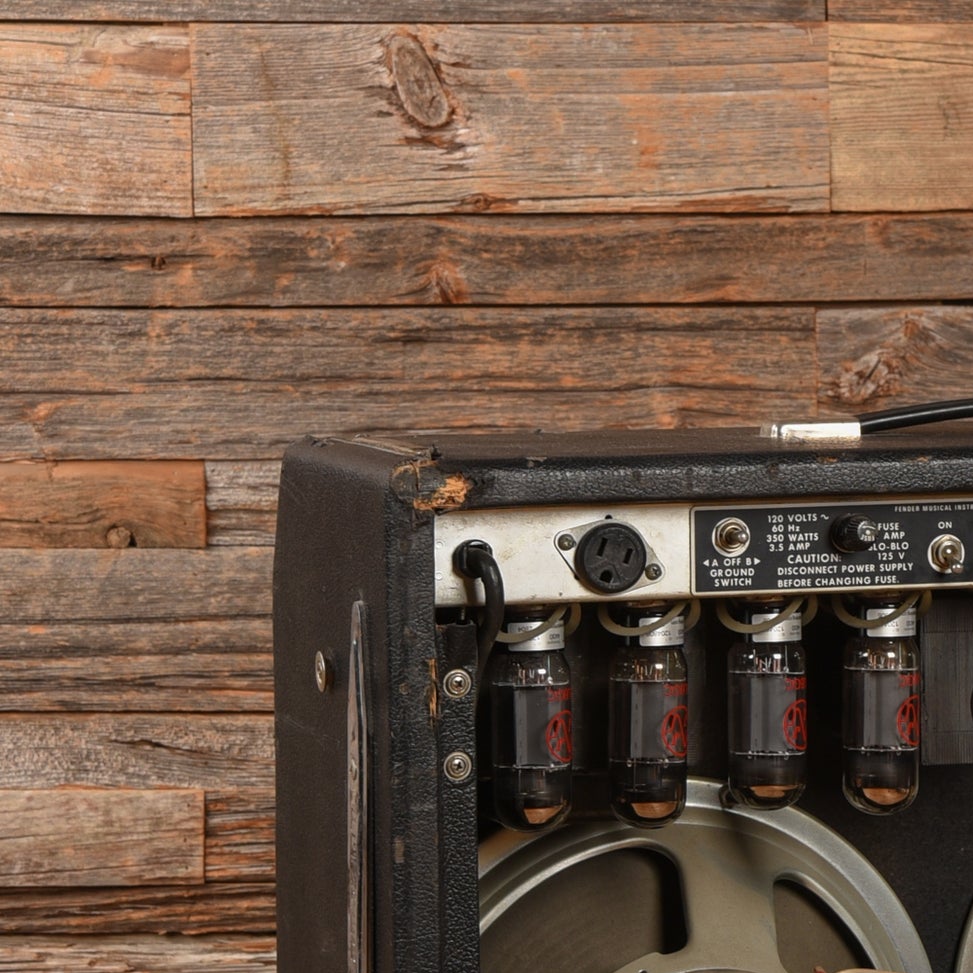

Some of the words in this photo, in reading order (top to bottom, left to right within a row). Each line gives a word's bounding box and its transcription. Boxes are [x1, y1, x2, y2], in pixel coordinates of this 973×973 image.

[923, 504, 952, 512] MUSICAL
[768, 514, 784, 523] 120
[788, 514, 817, 522] VOLTS
[772, 524, 784, 532] 60
[788, 524, 800, 532] Hz
[878, 522, 899, 530] FUSE
[938, 521, 952, 529] ON
[766, 534, 784, 542] 350
[788, 533, 819, 541] WATTS
[883, 531, 905, 540] AMP
[769, 543, 784, 551] 3.5
[788, 542, 810, 550] AMP
[787, 554, 842, 564] CAUTION:
[878, 552, 893, 560] 125
[898, 552, 905, 560] V
[712, 559, 718, 567] A
[724, 558, 741, 566] OFF
[710, 568, 755, 577] GROUND
[777, 566, 837, 575] DISCONNECT
[842, 564, 875, 573] POWER
[879, 562, 913, 572] SUPPLY
[714, 578, 751, 587] SWITCH
[777, 578, 813, 588] BEFORE
[815, 576, 871, 586] CHANGING
[875, 575, 900, 584] FUSE.
